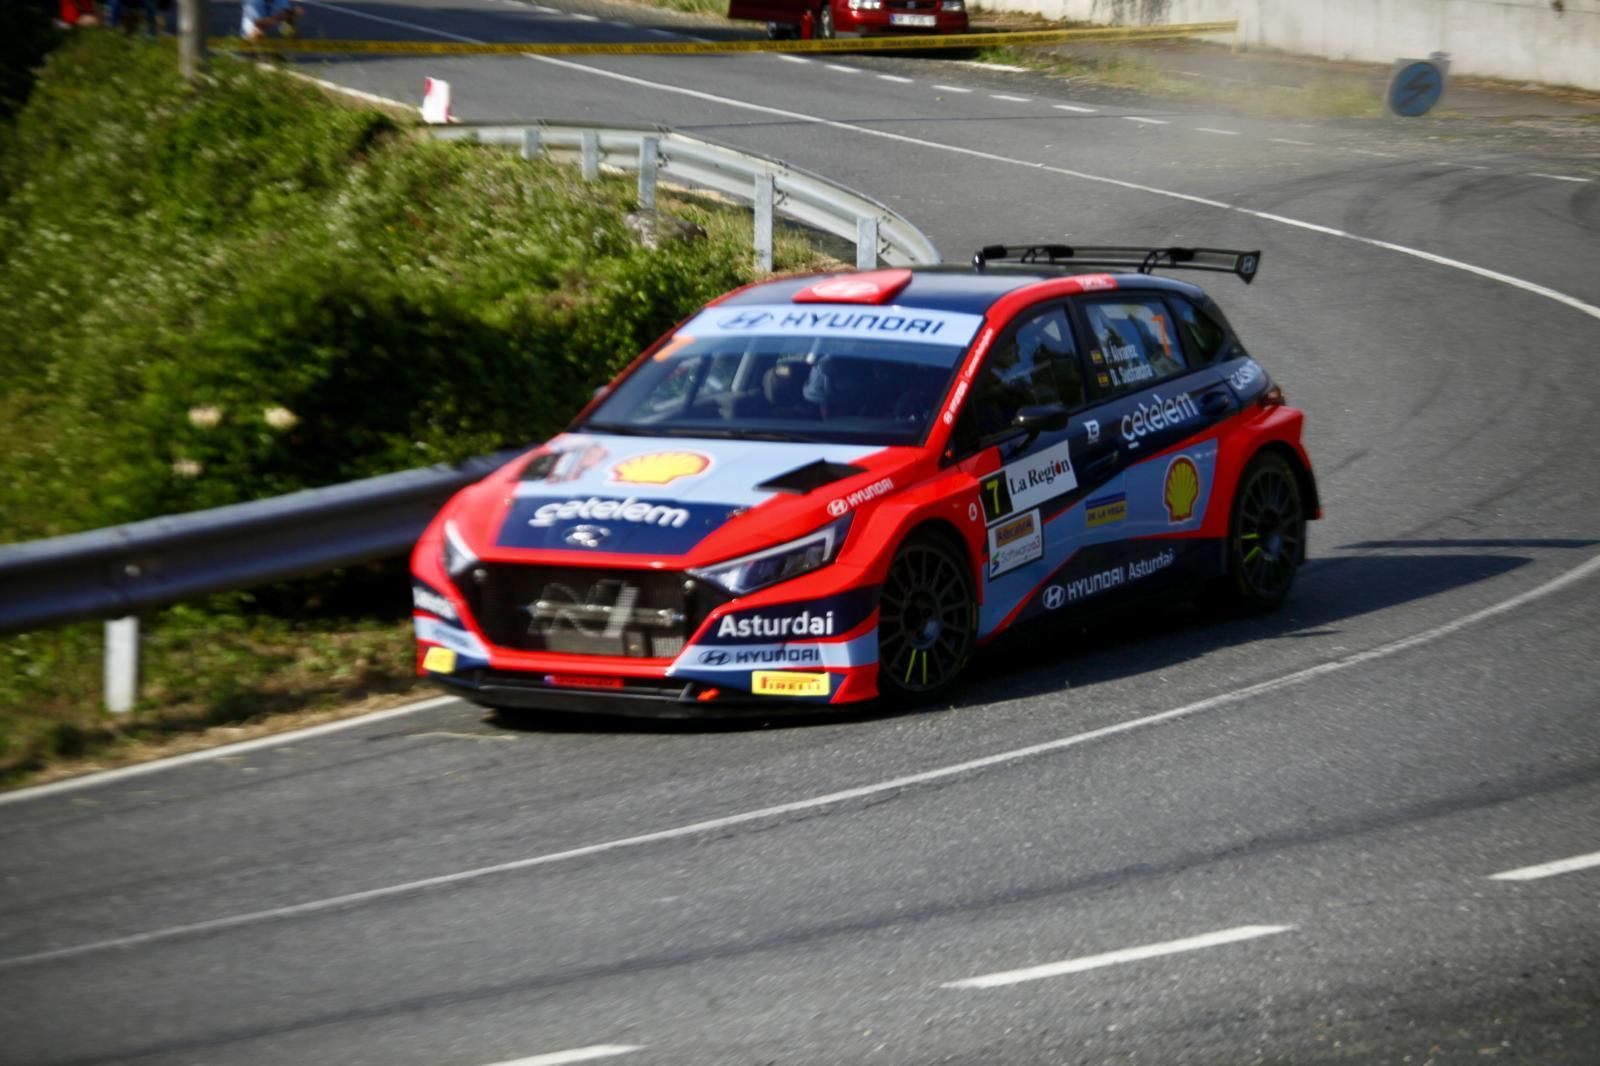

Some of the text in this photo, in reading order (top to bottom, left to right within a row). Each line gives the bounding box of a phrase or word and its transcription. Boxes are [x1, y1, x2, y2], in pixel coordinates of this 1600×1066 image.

[779, 312, 945, 335] HYUNDAI
[1152, 315, 1173, 357] 7
[848, 479, 894, 508] HYUNDAI
[986, 479, 1000, 515] 7
[1009, 477, 1028, 496] La
[1067, 549, 1175, 601] HYUNDAI Asturdai
[717, 610, 835, 638] Asturdai
[736, 648, 819, 663] HYUNDAI
